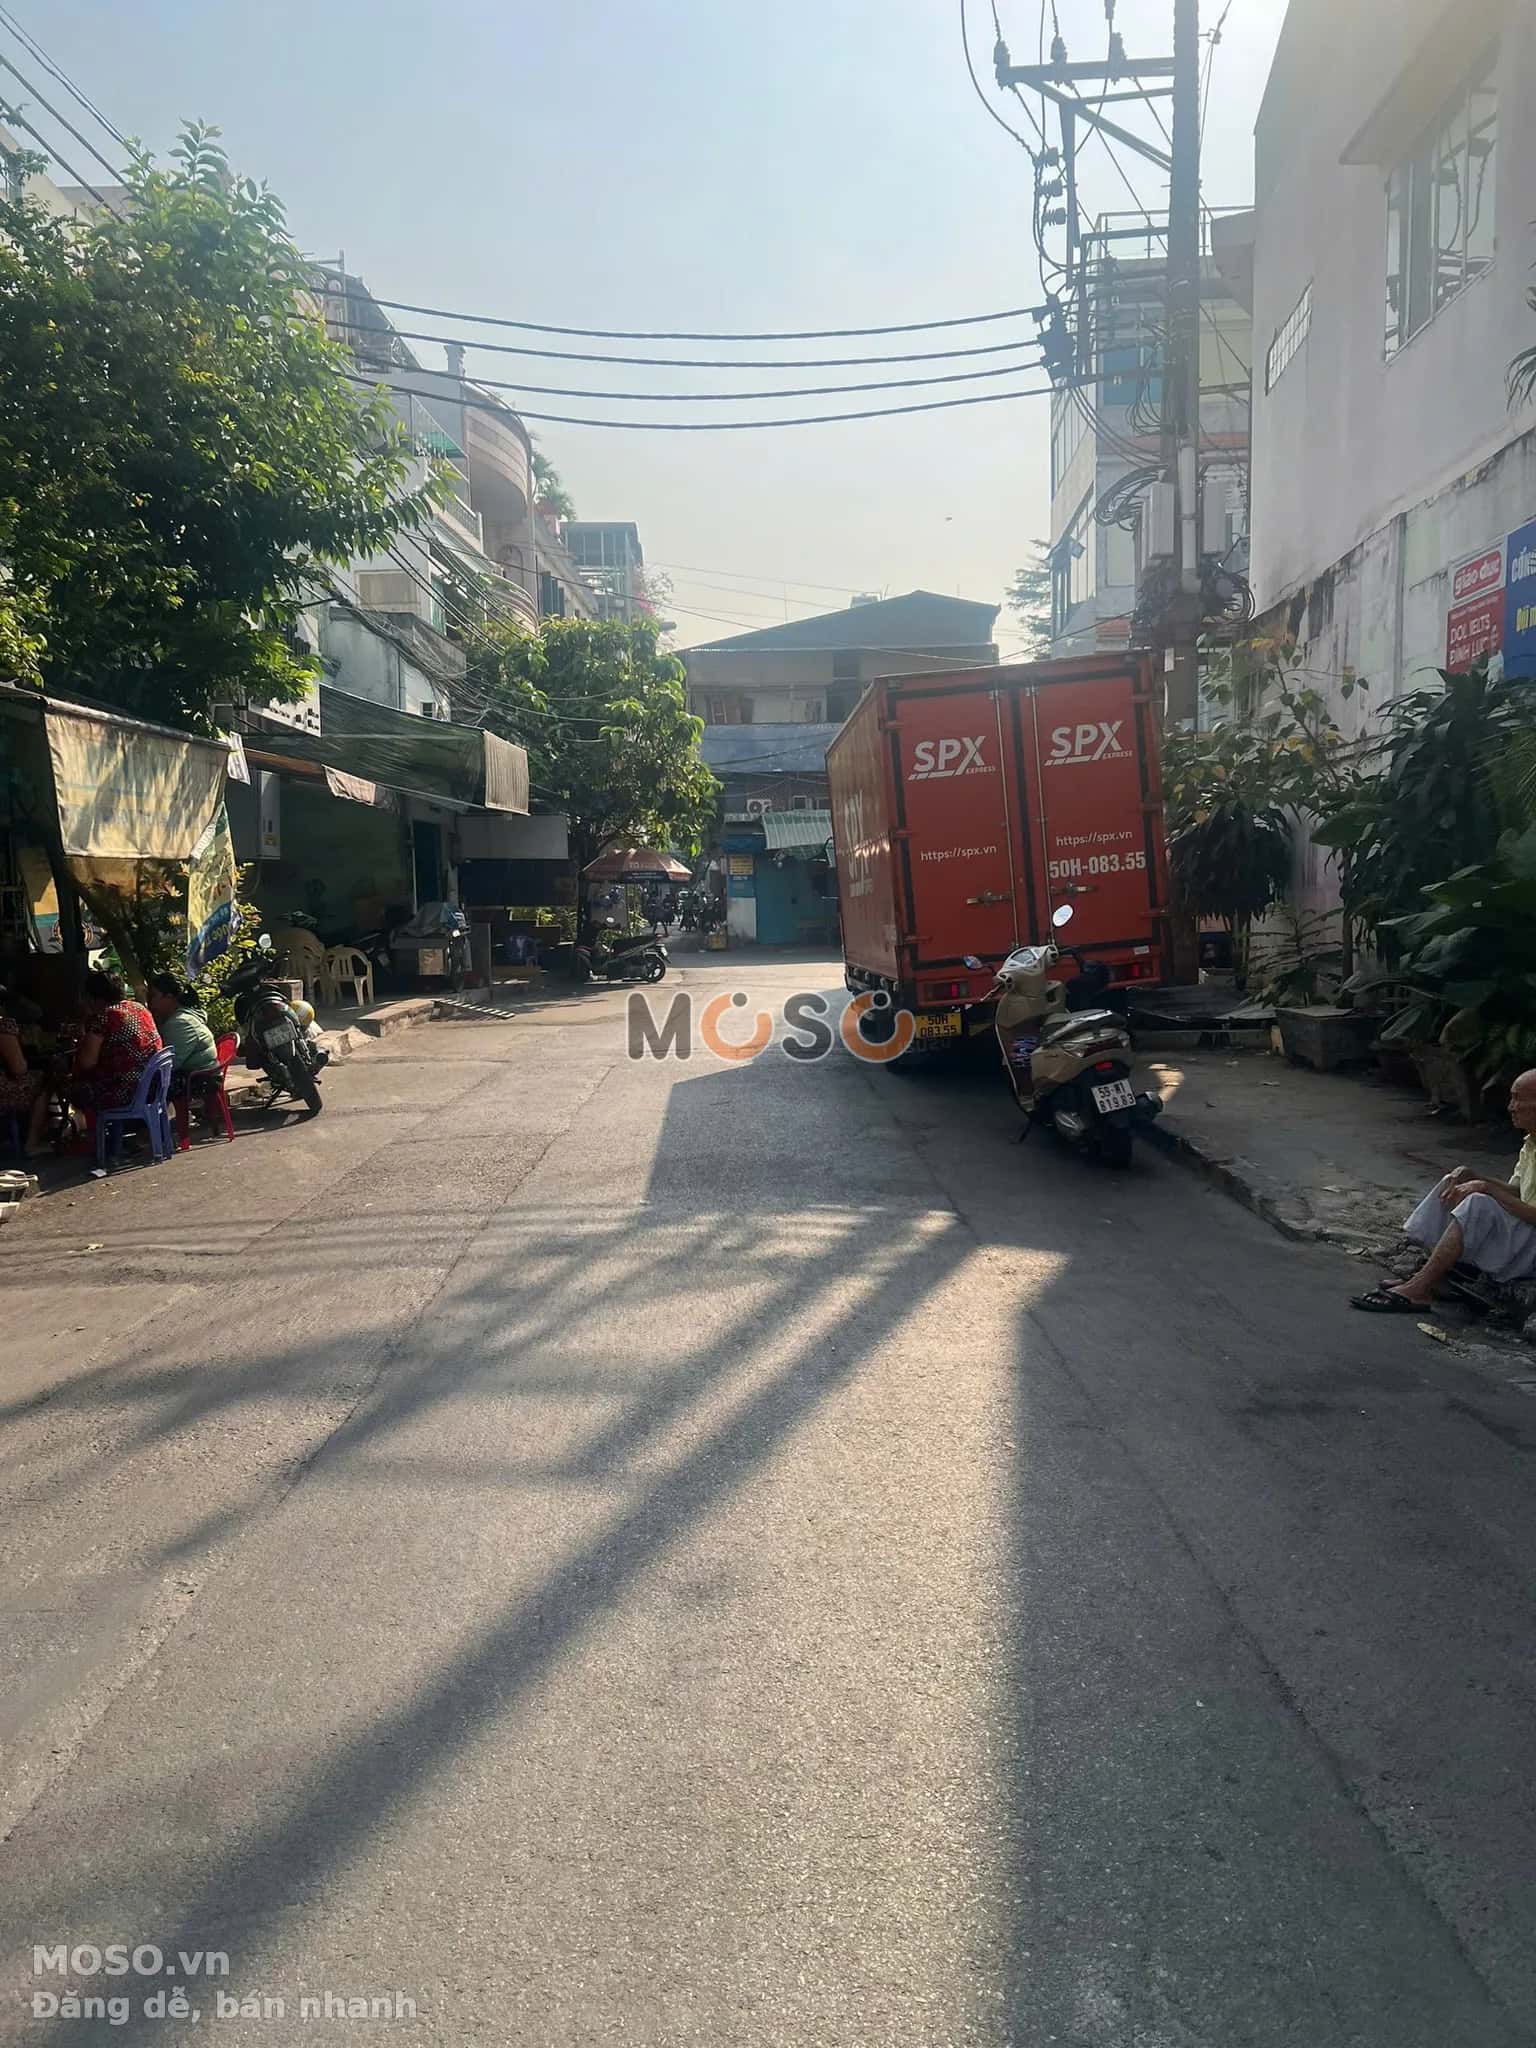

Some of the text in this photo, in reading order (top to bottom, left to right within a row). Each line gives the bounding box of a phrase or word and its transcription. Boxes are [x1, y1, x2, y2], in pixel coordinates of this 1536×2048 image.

[1050, 720, 1124, 761] SPX
[913, 735, 986, 775] SPX
[1056, 829, 1133, 848] https://spx.vn
[920, 844, 997, 862] https://spx.vn
[1049, 851, 1146, 879] 50H-083.55
[927, 1015, 949, 1025] 50H
